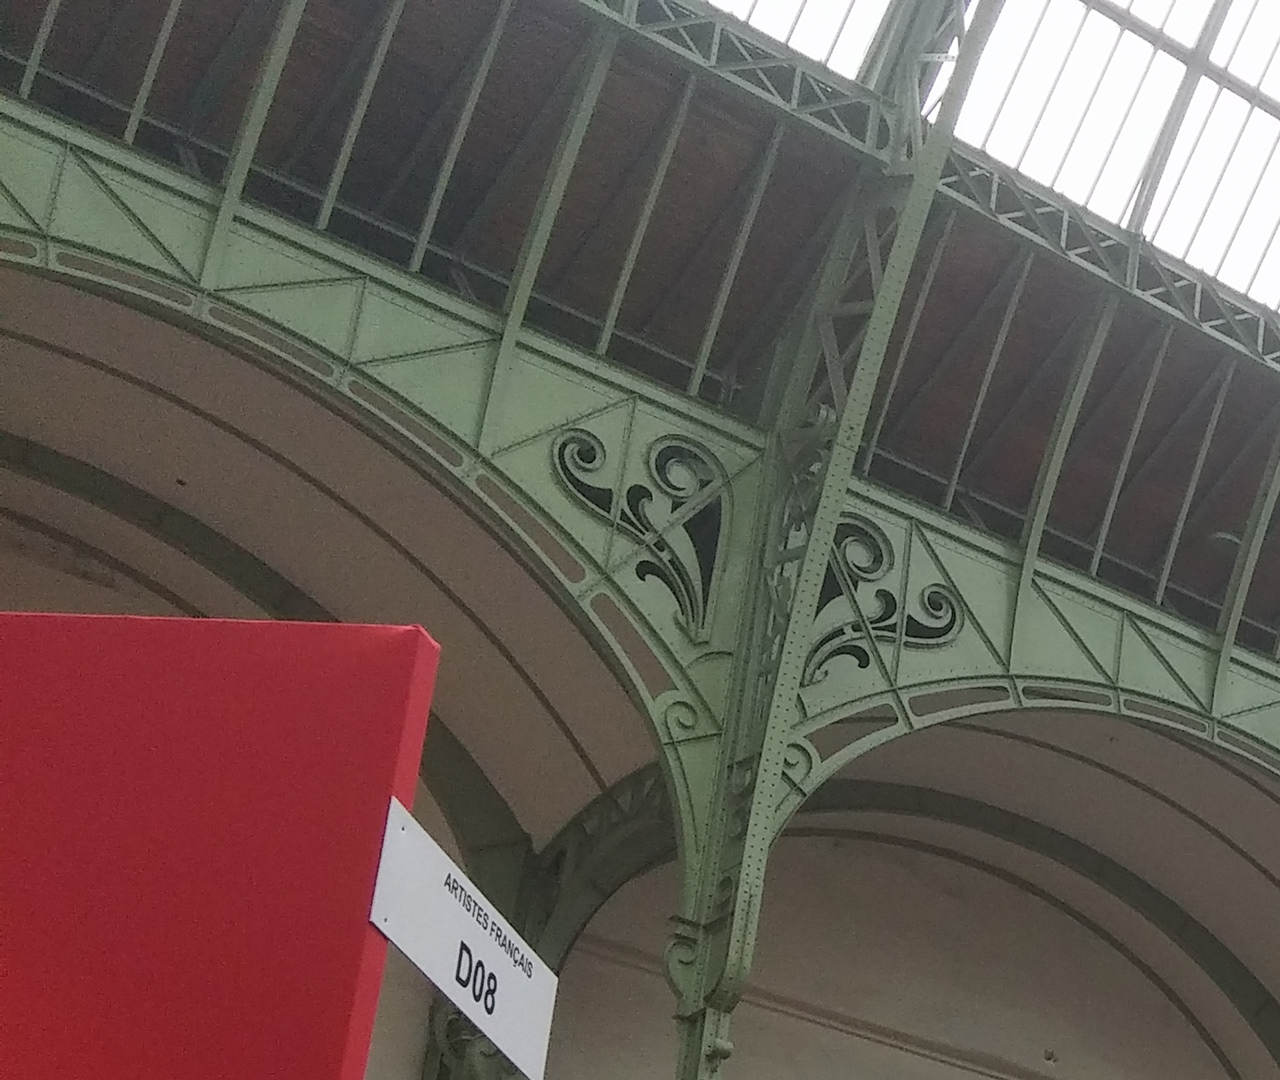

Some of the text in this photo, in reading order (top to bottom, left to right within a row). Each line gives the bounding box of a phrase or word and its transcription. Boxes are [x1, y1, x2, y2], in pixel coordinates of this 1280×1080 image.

[443, 872, 534, 980] ARTISTES FRANÇAIS
[455, 939, 498, 1016] D08
